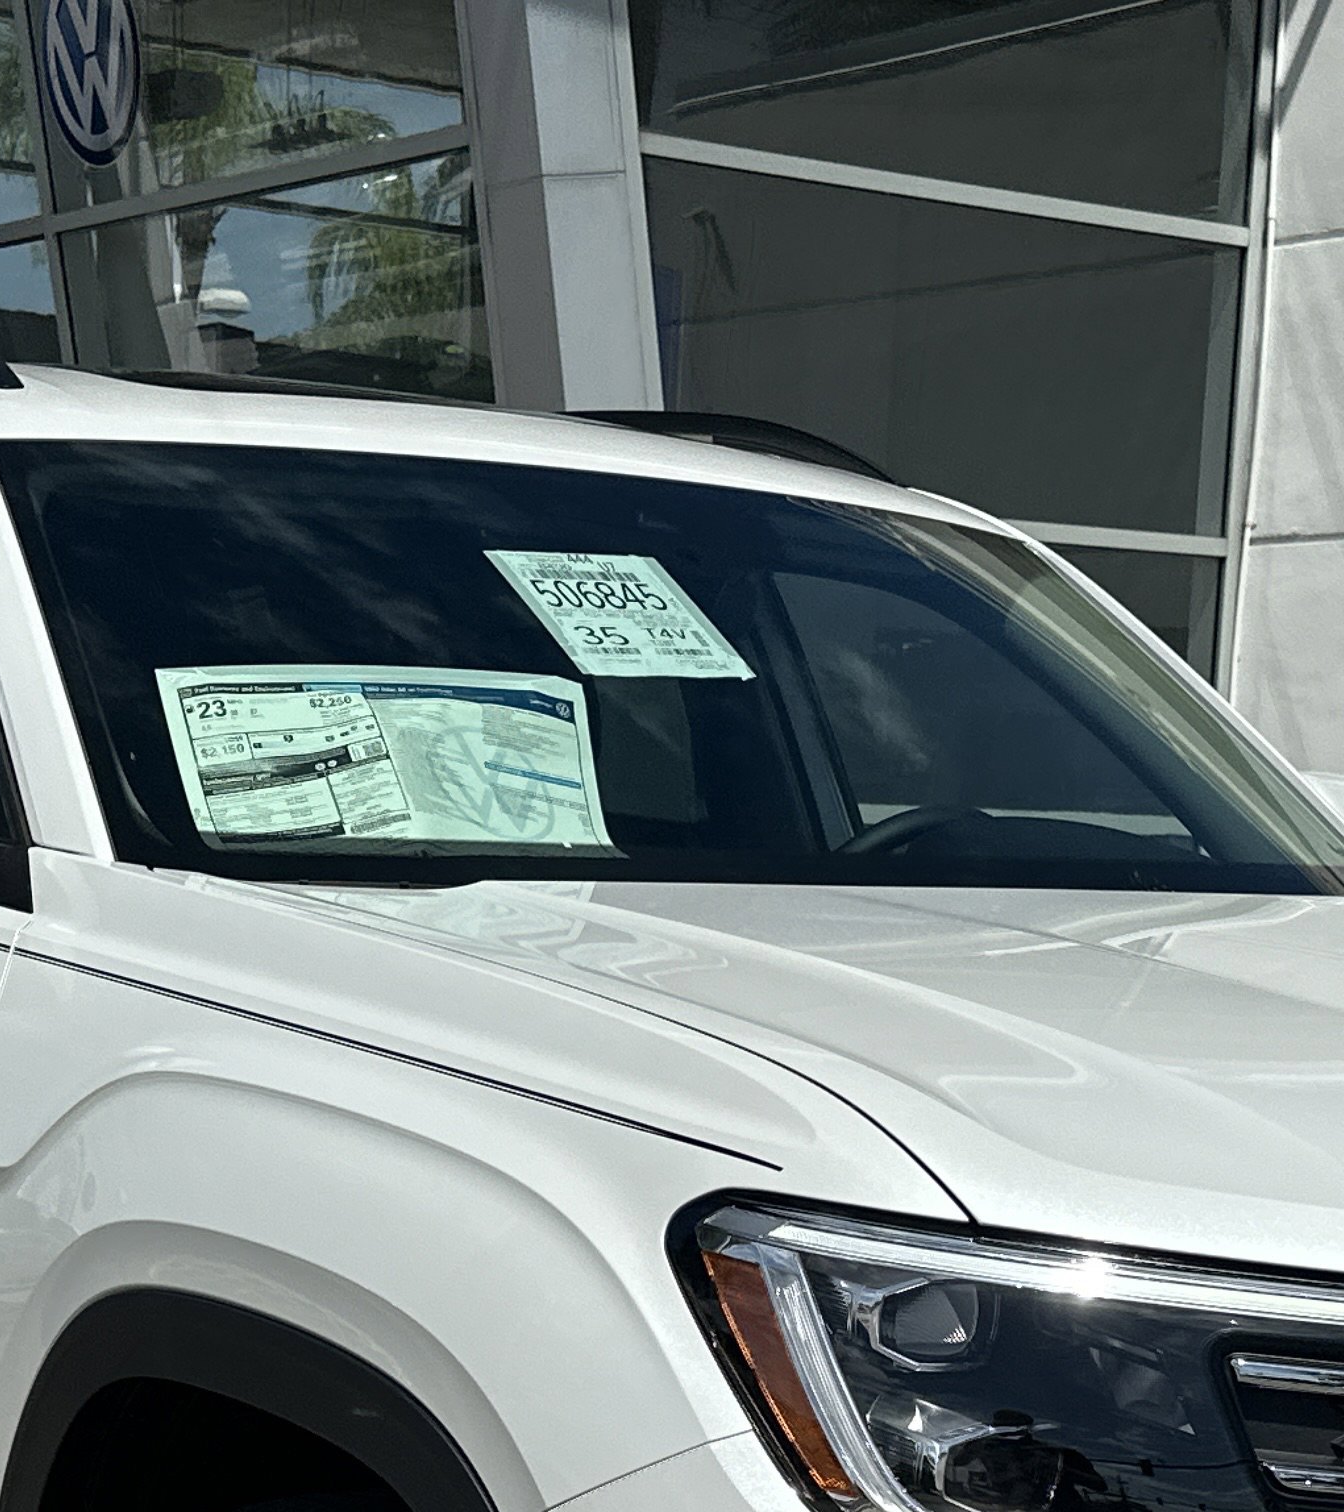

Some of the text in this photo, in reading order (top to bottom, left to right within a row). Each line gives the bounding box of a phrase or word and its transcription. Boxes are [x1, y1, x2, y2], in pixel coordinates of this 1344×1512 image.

[529, 580, 668, 610] 506845
[574, 626, 630, 645] 35
[196, 700, 227, 719] 23
